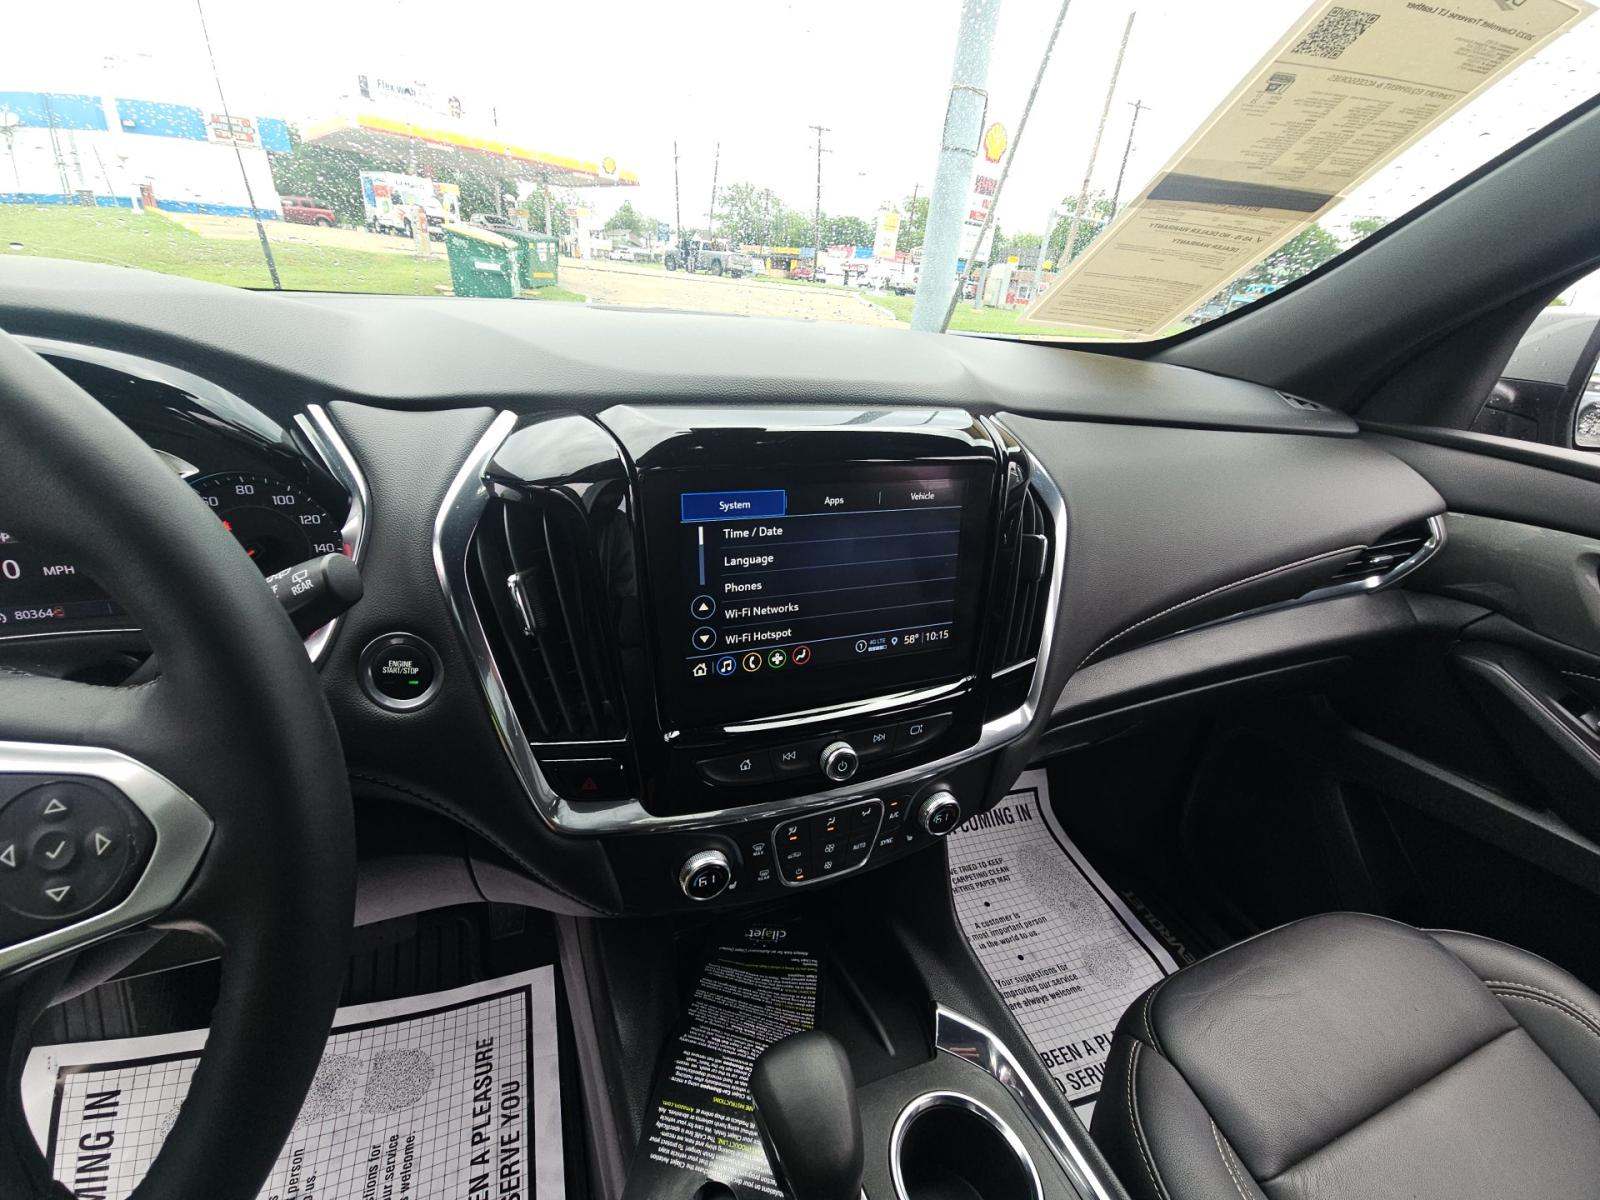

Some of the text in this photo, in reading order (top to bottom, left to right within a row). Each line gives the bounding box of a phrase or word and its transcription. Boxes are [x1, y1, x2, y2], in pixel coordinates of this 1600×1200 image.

[235, 484, 254, 495] 80
[272, 495, 295, 505] 100
[719, 492, 935, 511] System Apps Vehicle
[299, 514, 320, 525] 120
[723, 528, 749, 538] Time
[759, 526, 783, 537] Date
[313, 543, 335, 553] 140
[2, 559, 75, 579] 0 MPH
[724, 554, 774, 568] Language
[290, 579, 314, 596] REAR
[724, 581, 762, 594] Phones
[14, 608, 54, 620] 80364
[725, 602, 799, 619] Wi-Fi Networks
[725, 628, 792, 645] Wi-Fi Hotspot
[925, 630, 949, 641] 10:15
[388, 660, 413, 668] ENGINE
[889, 811, 899, 820] A/C
[1015, 803, 1032, 822] IN
[960, 864, 978, 874] TRIED
[979, 861, 987, 869] TO
[988, 858, 1003, 867] KEEP
[989, 866, 1010, 876] CLEAN
[960, 883, 975, 893] THIS
[975, 877, 996, 889] PAPER
[996, 874, 1011, 884] MAT
[971, 915, 1048, 940] most important person
[981, 914, 1012, 928] customer
[749, 928, 787, 943] cilajet
[987, 940, 999, 948] the
[999, 933, 1020, 945] world
[1019, 932, 1027, 940] to
[996, 962, 1069, 988] Your suggestions for
[1039, 981, 1051, 990] our
[1051, 973, 1079, 986] service
[1008, 985, 1086, 1011] are always welcome.
[1040, 1043, 1083, 1068] BEEN
[1082, 1040, 1098, 1056] A
[471, 1036, 494, 1147] PLEASURE
[83, 1089, 122, 1120] IN
[500, 1080, 520, 1127] YOU
[384, 1134, 400, 1181] service
[400, 1130, 416, 1194] welcome.
[470, 1149, 491, 1166] A
[287, 1148, 305, 1194] person
[363, 1143, 381, 1200] tions for
[305, 1170, 317, 1192] us.
